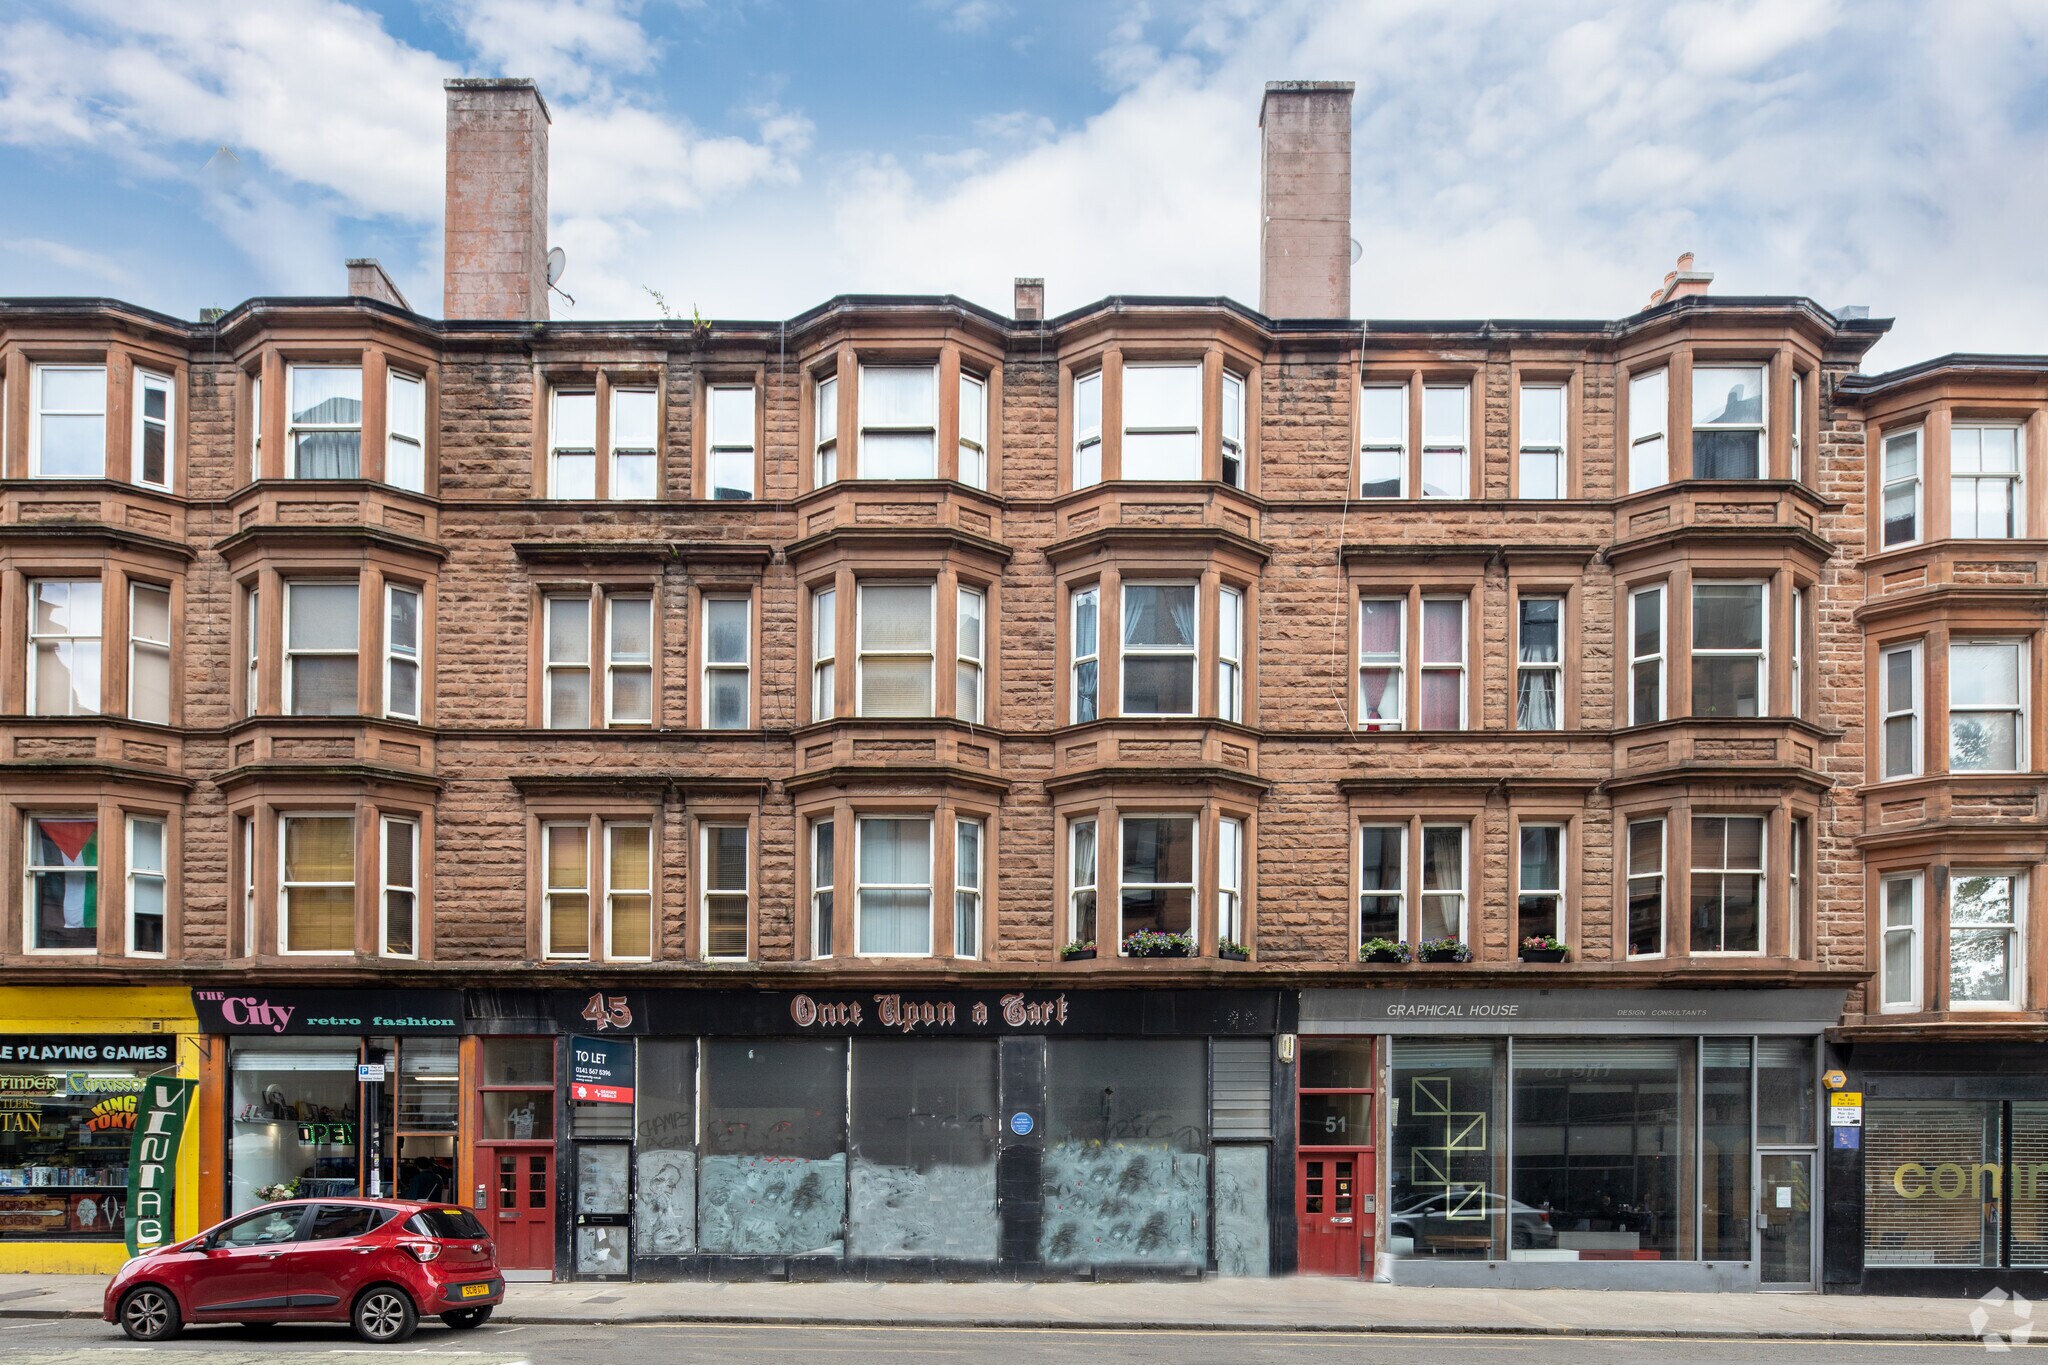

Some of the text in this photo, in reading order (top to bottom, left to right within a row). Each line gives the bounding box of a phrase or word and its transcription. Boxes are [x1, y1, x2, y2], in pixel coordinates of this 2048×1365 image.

[197, 991, 225, 1001] THE
[222, 997, 295, 1033] City
[581, 992, 632, 1031] 45
[790, 992, 1068, 1033] Once Upon a Tart
[1387, 1004, 1519, 1016] GRAPHICAL HOUSE
[307, 1016, 456, 1026] retro fashion
[17, 1045, 98, 1060] PLAYING
[102, 1045, 168, 1060] GAMES
[576, 1050, 606, 1064] TO LET
[0, 1098, 34, 1109] TLERS
[90, 1094, 138, 1117] KING
[86, 1112, 139, 1132] TOKY
[1325, 1116, 1346, 1133] 51
[136, 1085, 184, 1255] VINTAG
